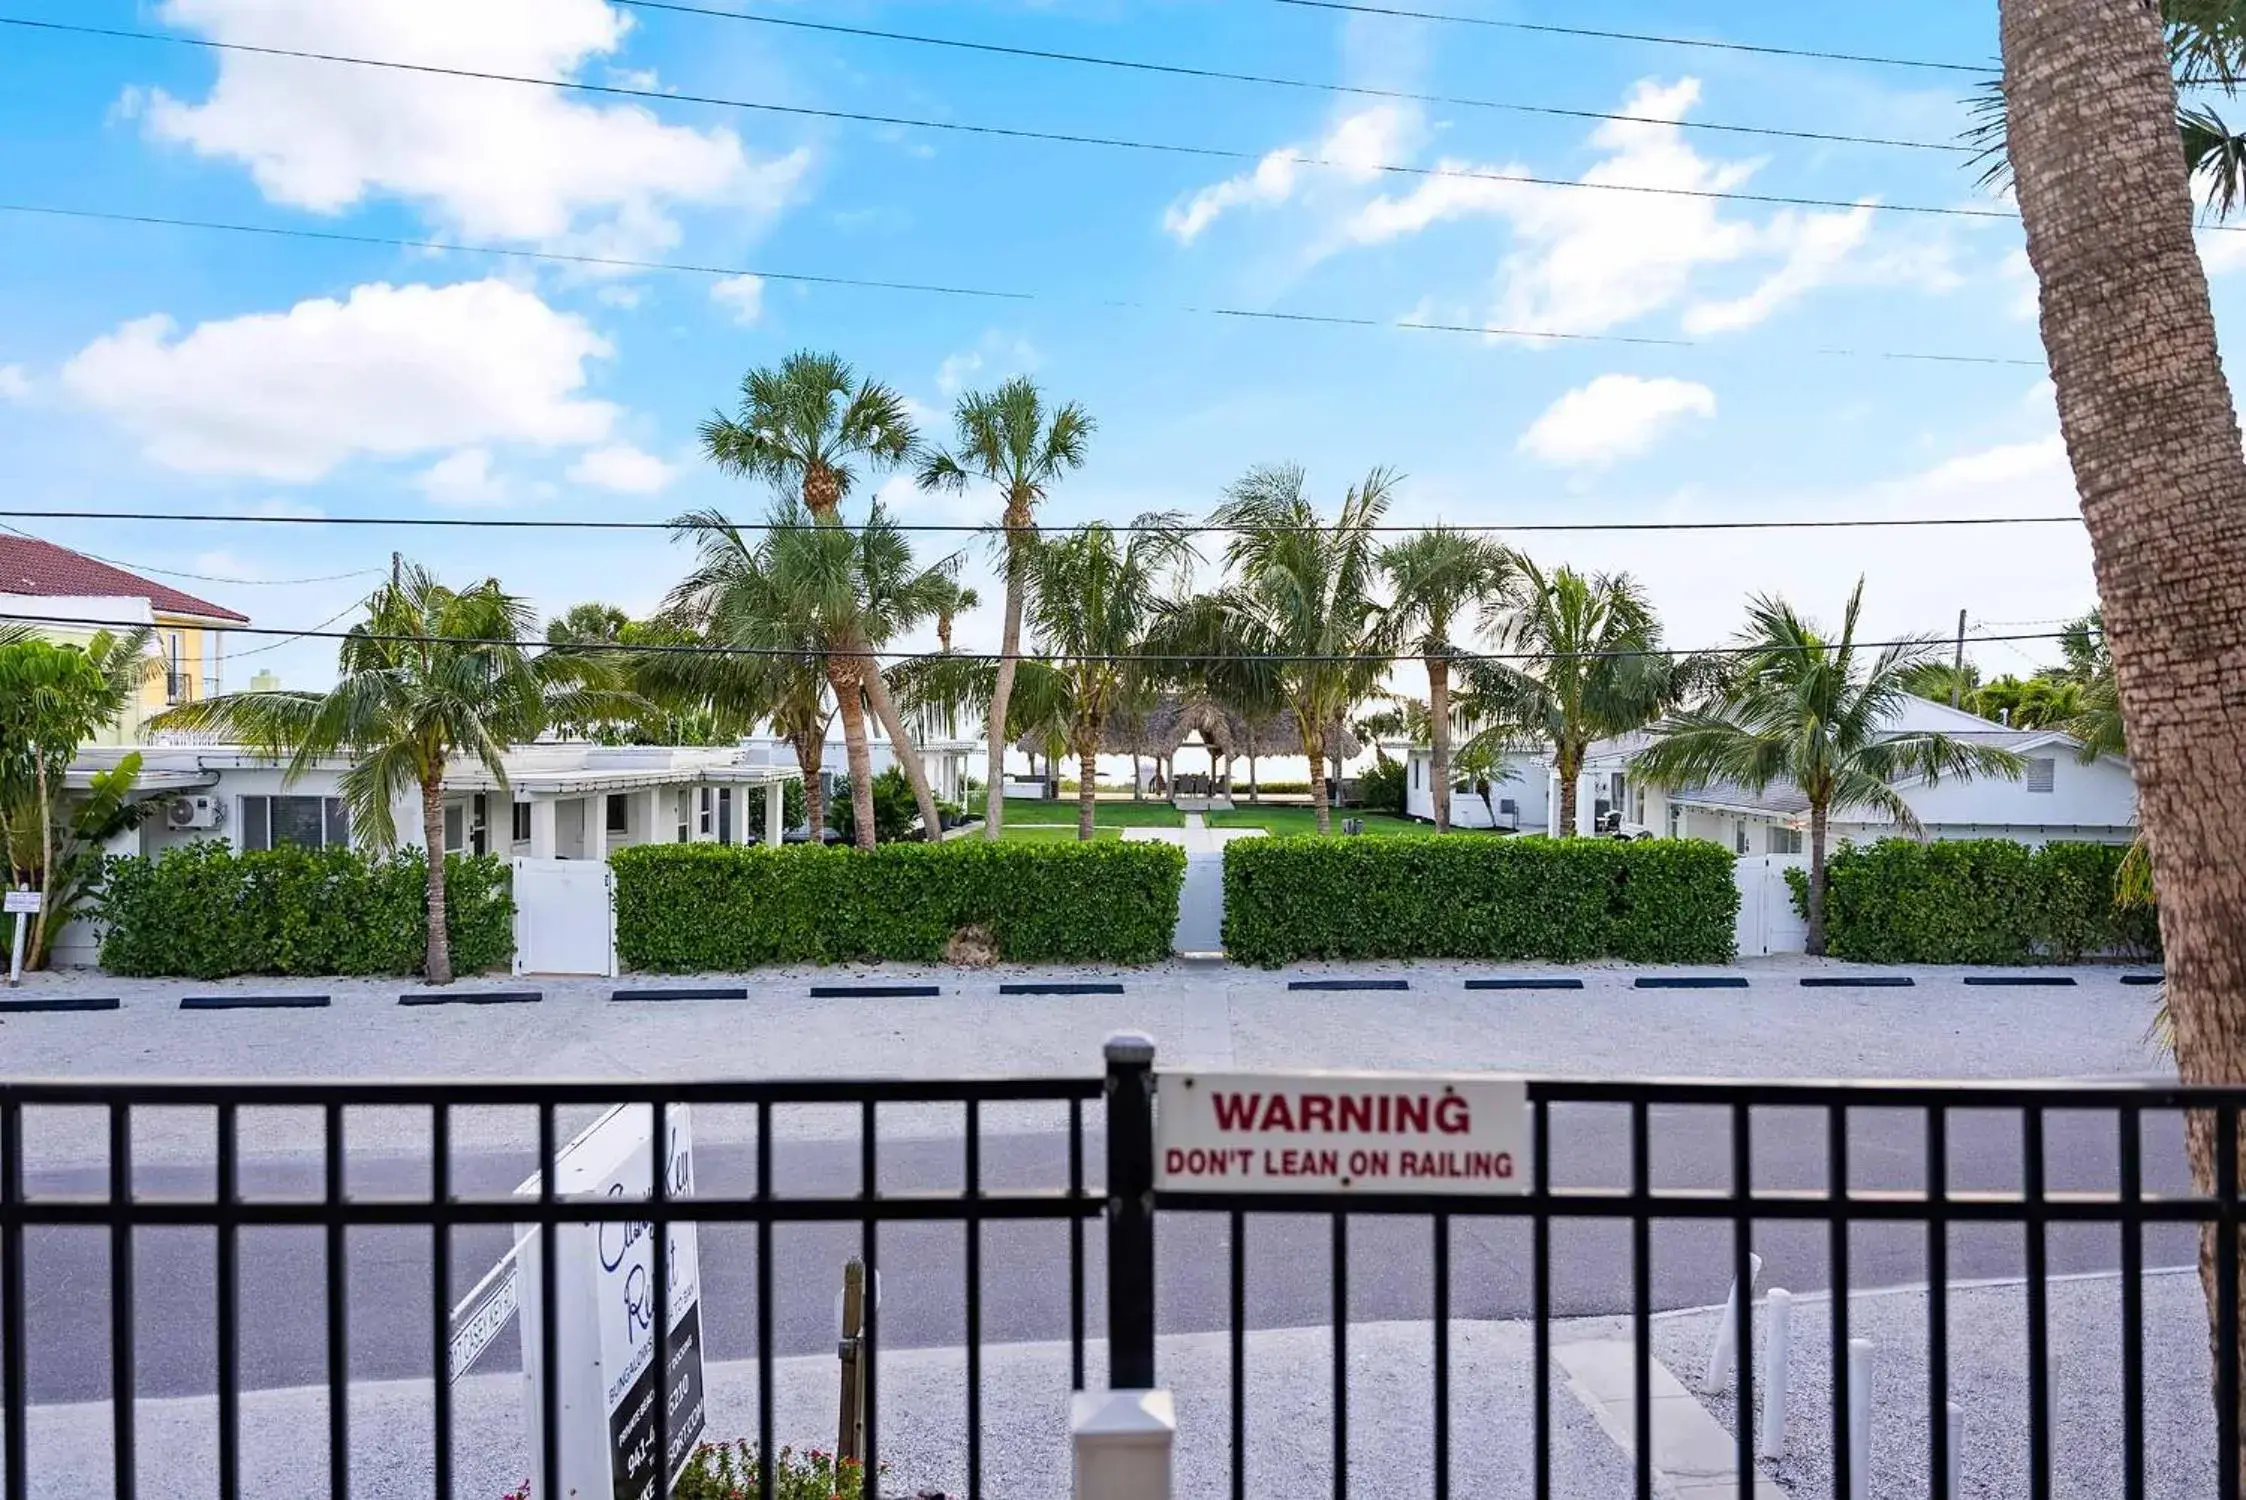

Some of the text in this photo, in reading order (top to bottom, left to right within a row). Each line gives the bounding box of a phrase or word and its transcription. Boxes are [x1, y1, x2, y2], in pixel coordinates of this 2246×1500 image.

[1212, 1092, 1471, 1134] WARNING
[1165, 1148, 1514, 1179] DON'T LEAN ON RAILING
